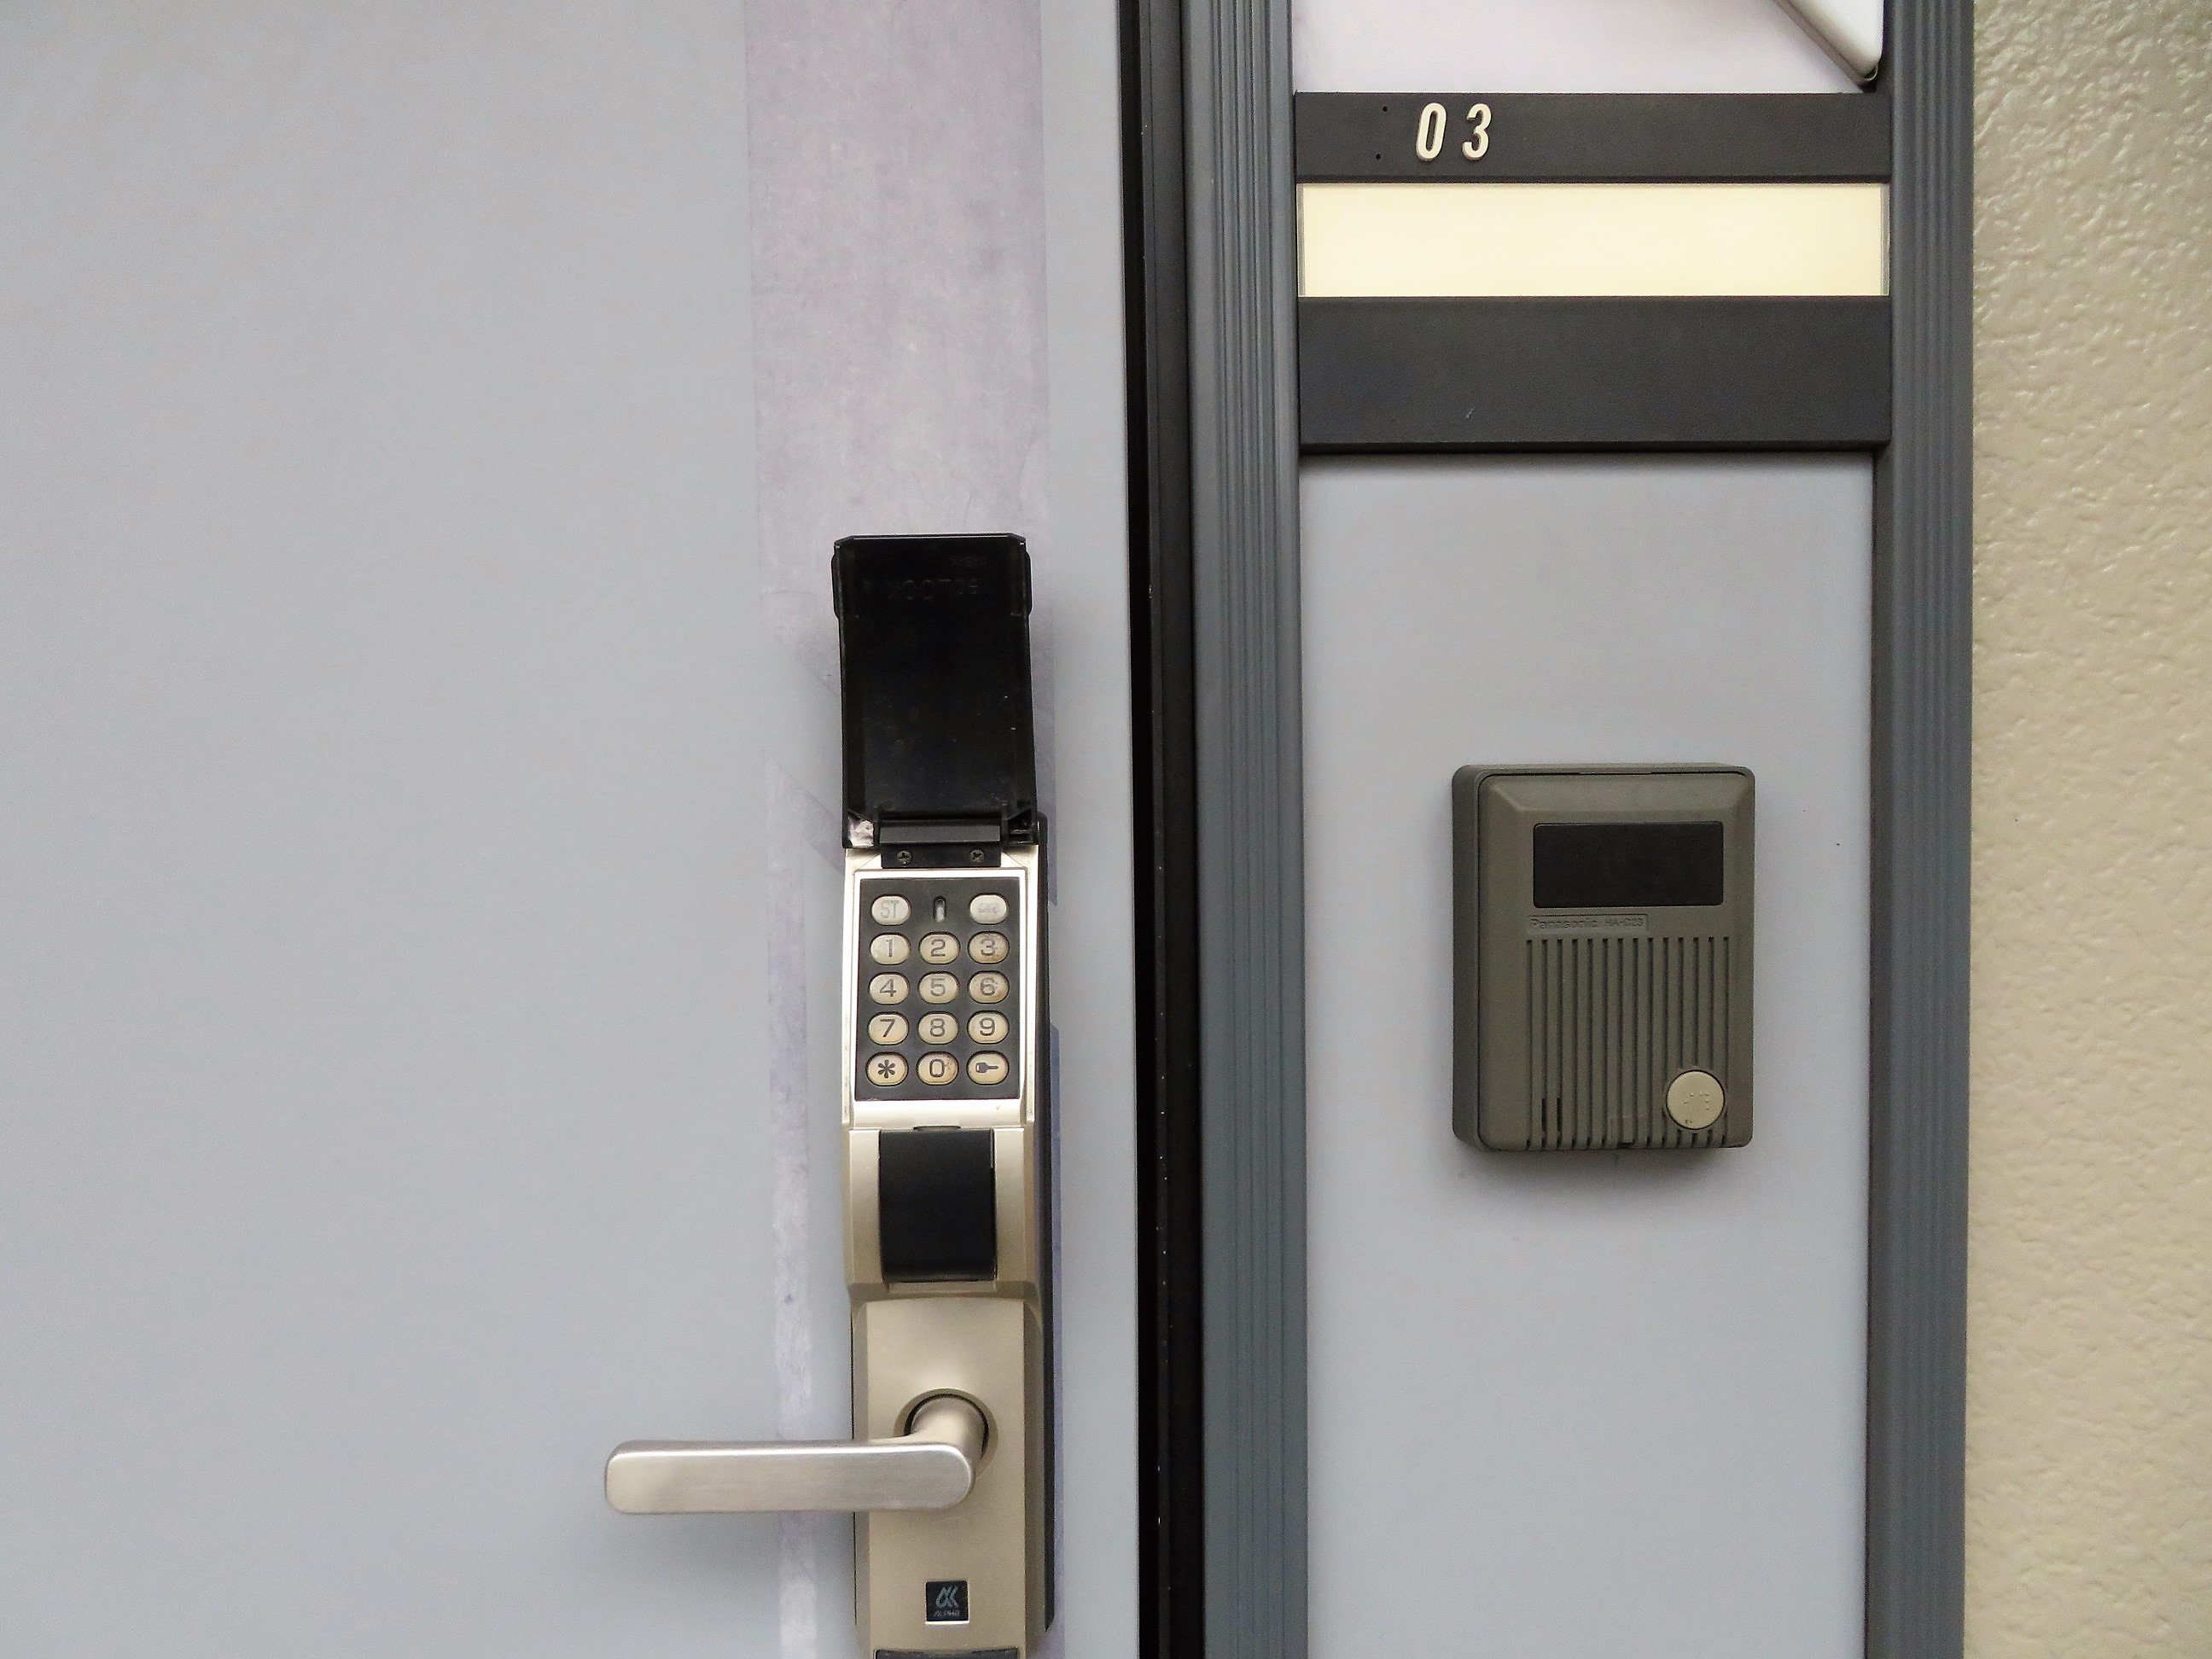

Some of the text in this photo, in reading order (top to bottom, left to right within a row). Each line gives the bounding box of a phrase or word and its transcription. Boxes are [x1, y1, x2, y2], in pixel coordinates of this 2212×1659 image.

[1530, 917, 1598, 929] Panasonic
[886, 938, 996, 957] 1 2 3
[879, 977, 996, 997] 4 5 6
[879, 1017, 996, 1038] 7 8 9
[928, 1058, 945, 1078] 0
